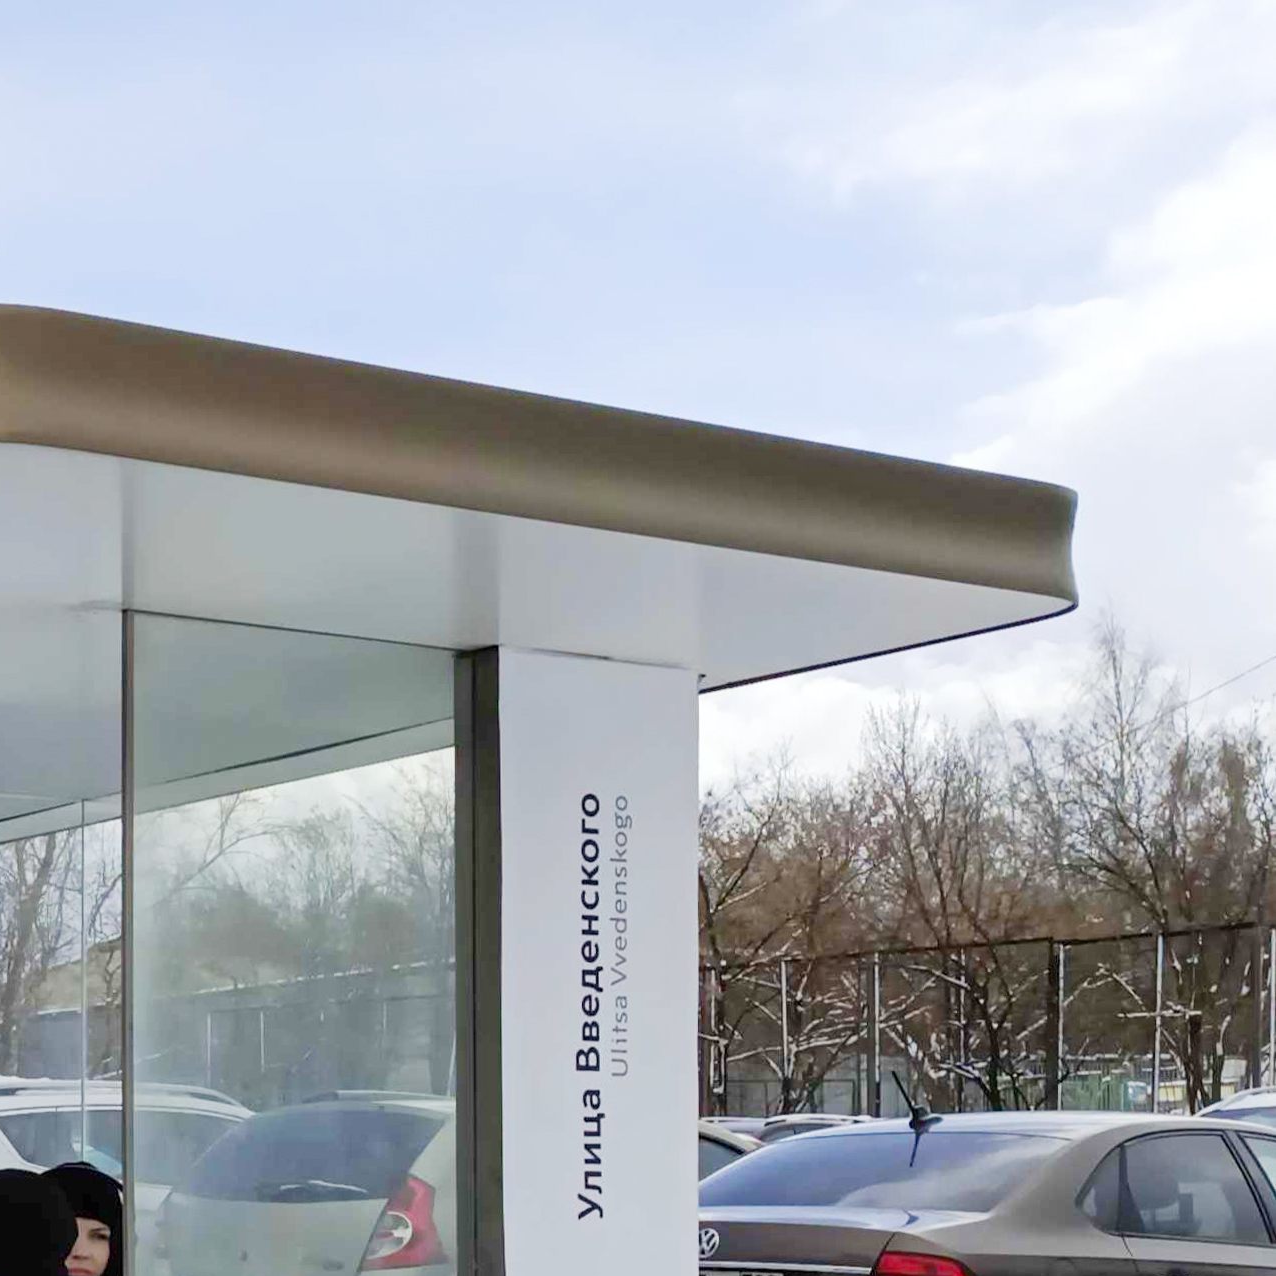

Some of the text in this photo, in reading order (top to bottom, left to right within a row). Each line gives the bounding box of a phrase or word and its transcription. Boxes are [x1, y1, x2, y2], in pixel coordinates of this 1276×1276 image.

[576, 793, 606, 1220] Улица Введенского
[610, 795, 632, 1077] Ulitsa Vvedenskogo
